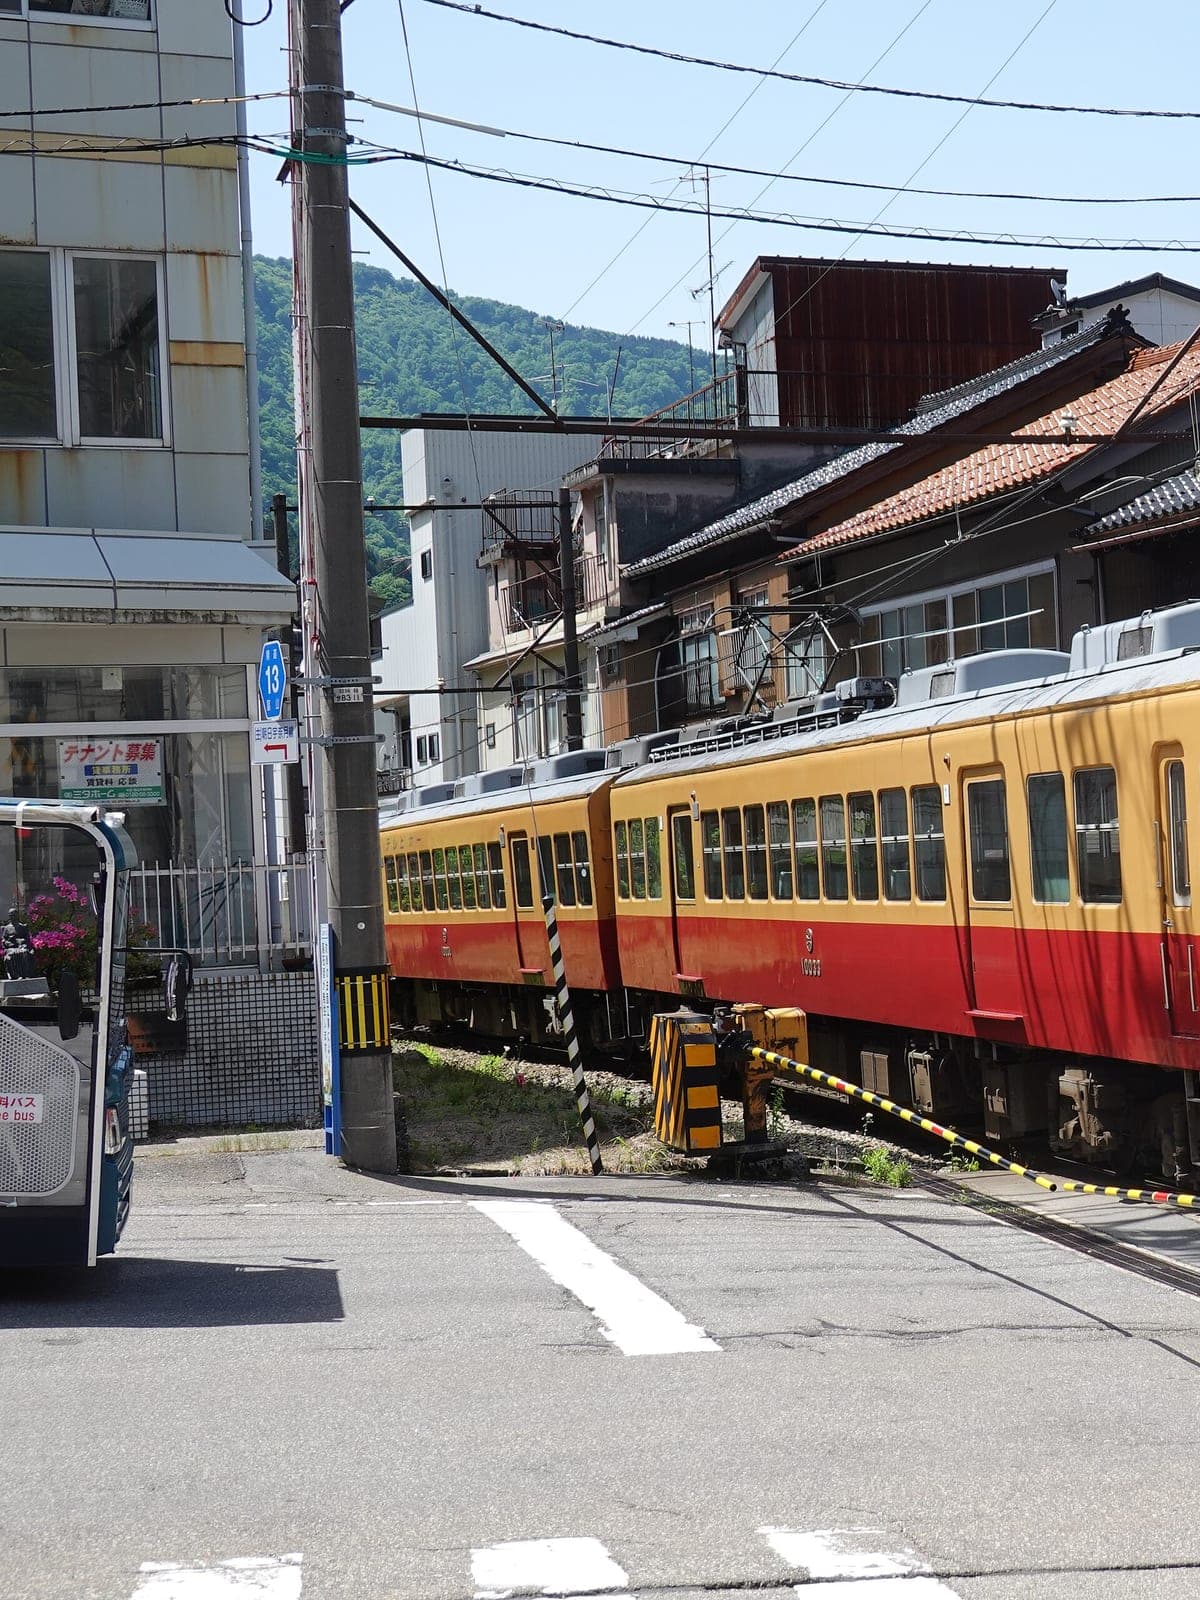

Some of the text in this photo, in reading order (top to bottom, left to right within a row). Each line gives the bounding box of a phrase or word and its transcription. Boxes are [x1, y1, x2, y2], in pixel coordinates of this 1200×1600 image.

[265, 664, 280, 695] 13
[64, 742, 157, 763] テナント募集
[14, 1110, 35, 1120] bus
